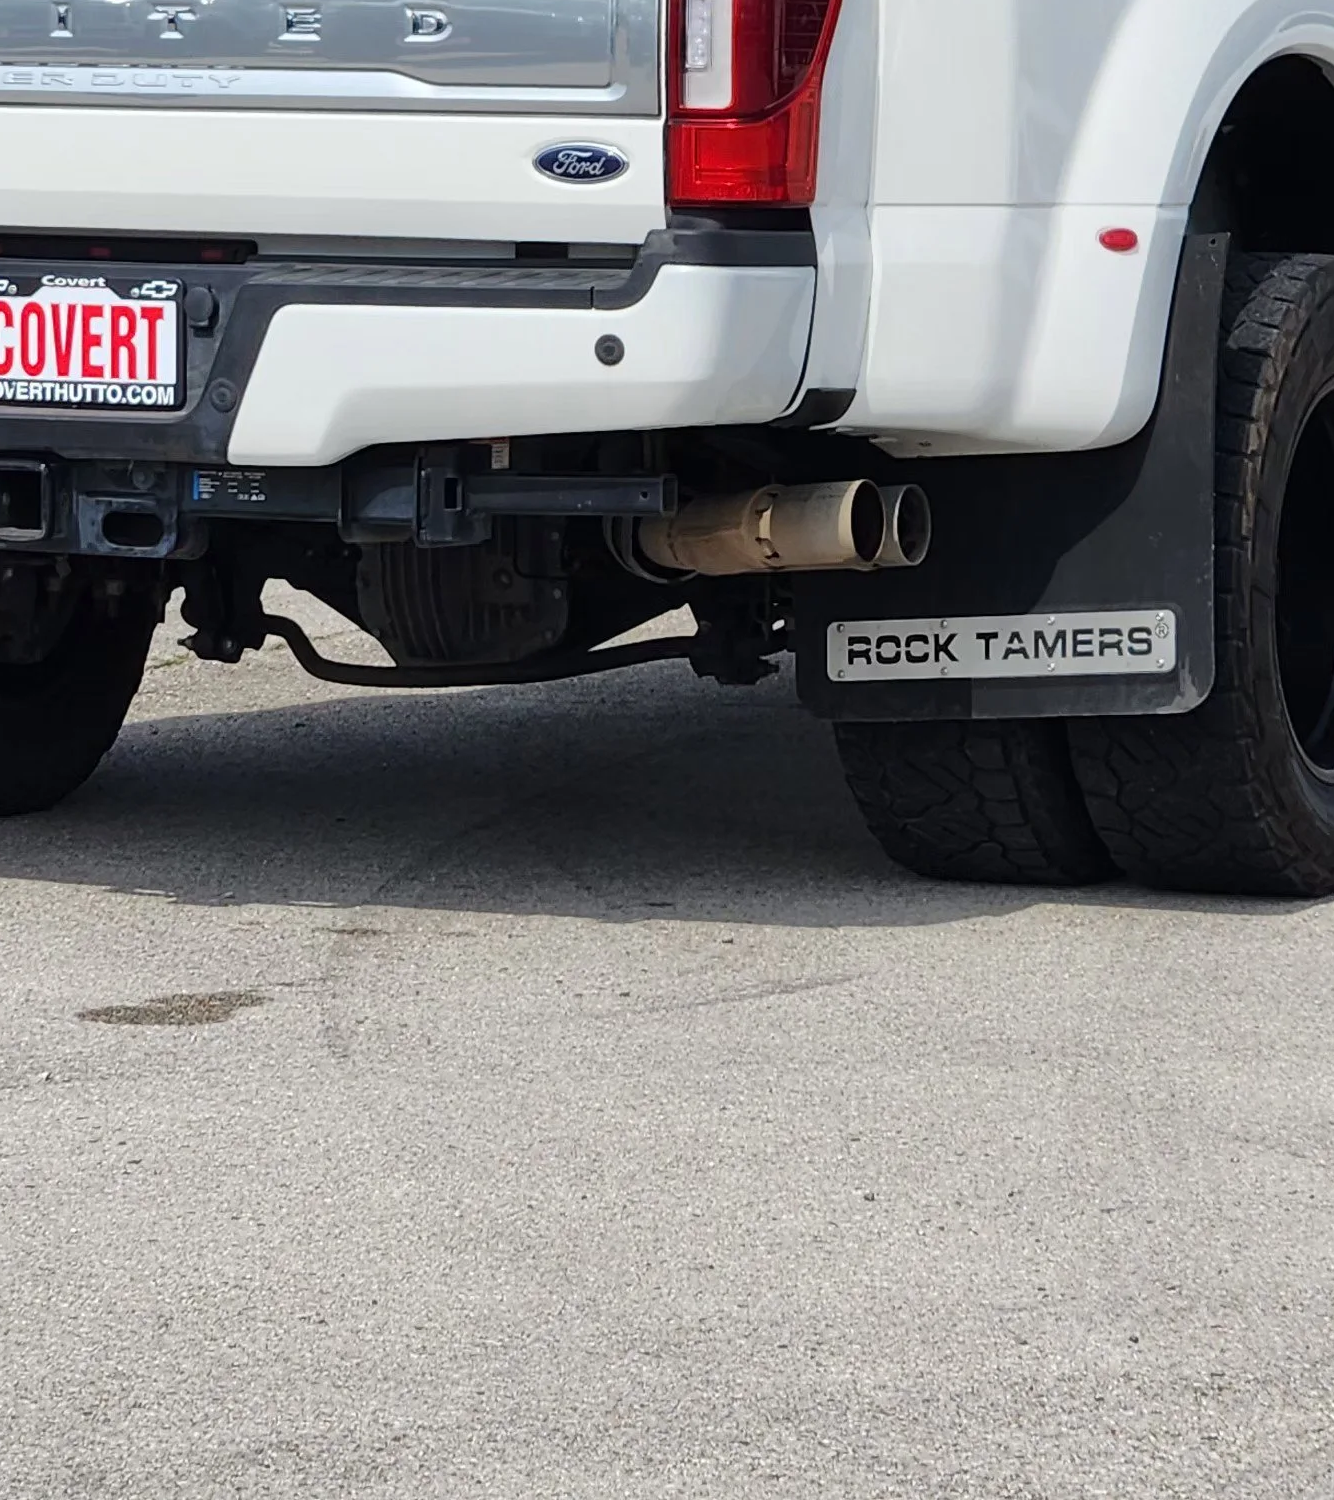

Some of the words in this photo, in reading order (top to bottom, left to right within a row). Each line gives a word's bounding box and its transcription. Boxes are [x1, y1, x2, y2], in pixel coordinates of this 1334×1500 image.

[91, 71, 242, 89] DUTY
[552, 150, 606, 175] Ford
[41, 275, 107, 287] Covert
[847, 633, 959, 665] ROCK
